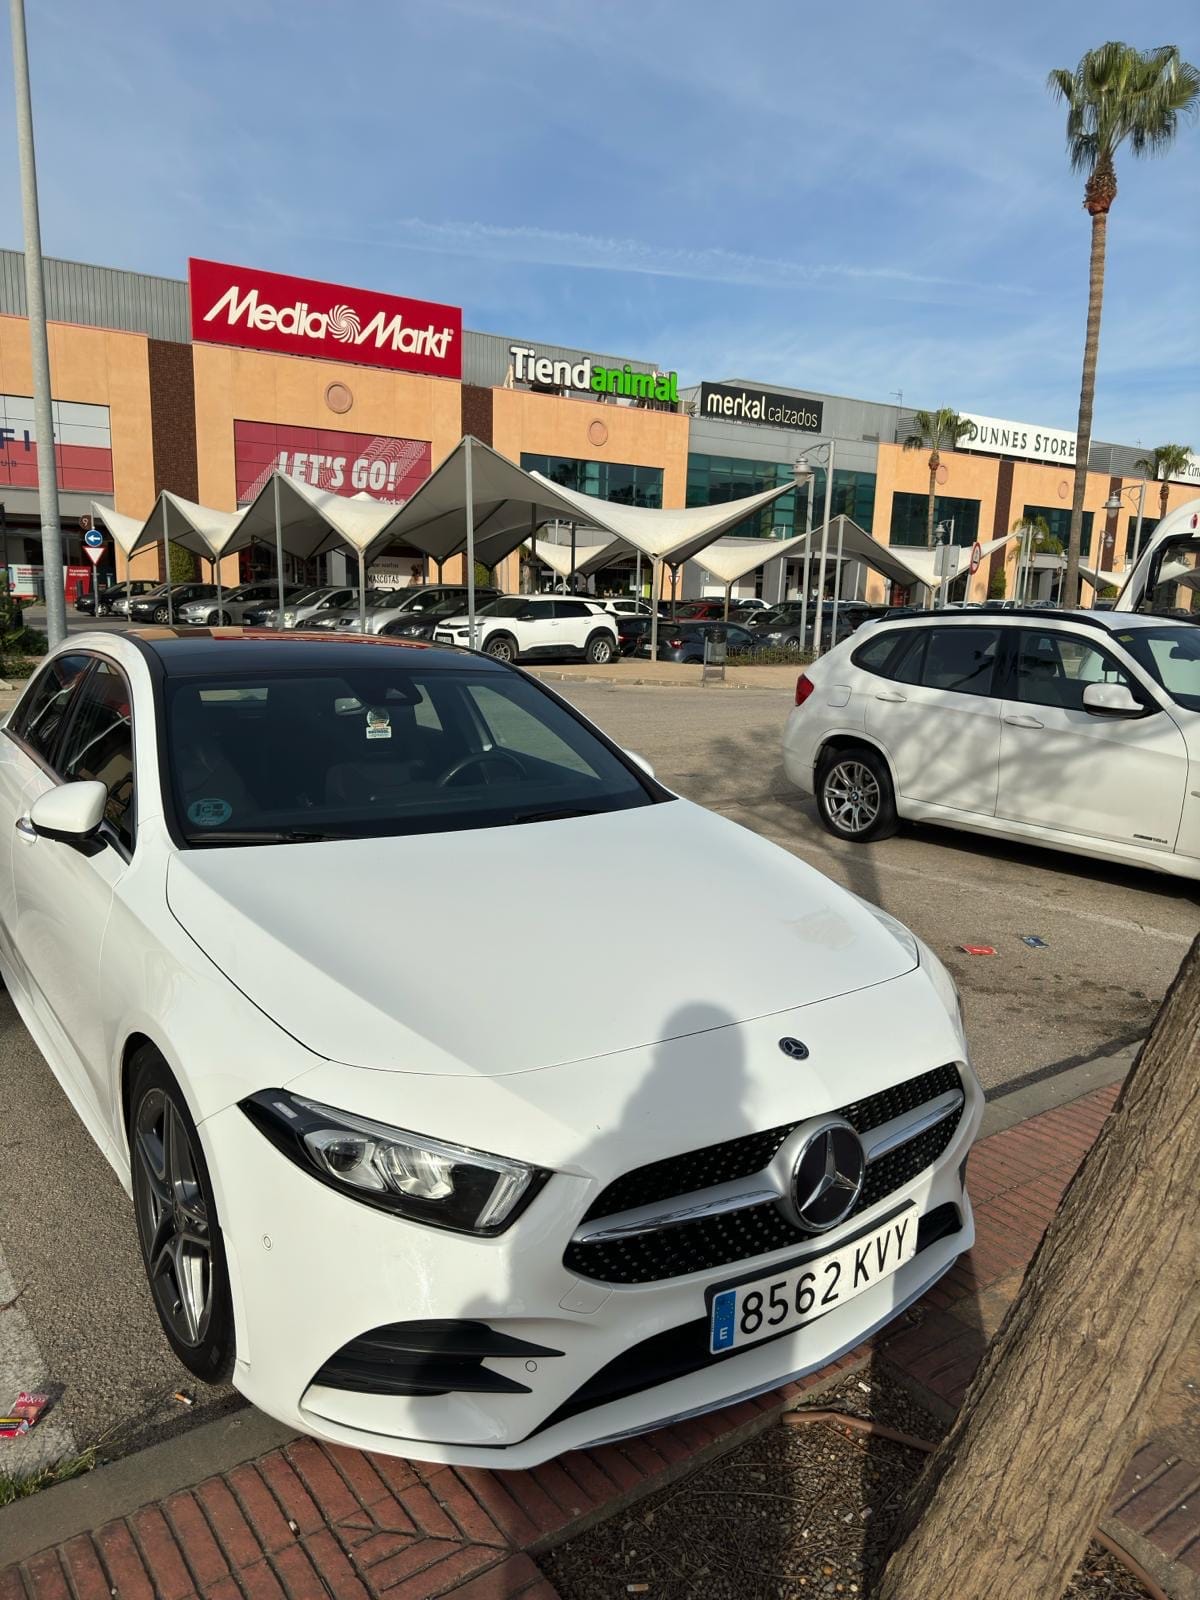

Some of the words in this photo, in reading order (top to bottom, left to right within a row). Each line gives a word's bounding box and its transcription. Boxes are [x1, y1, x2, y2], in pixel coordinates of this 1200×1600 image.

[203, 285, 328, 339] Media
[354, 311, 452, 359] Markt
[509, 346, 680, 403] Tiendanimal
[707, 391, 766, 421] merkal
[768, 404, 818, 428] calzados
[968, 423, 1028, 450] DUNNES
[278, 451, 346, 488] LET'S
[351, 458, 398, 492] GO!
[740, 1261, 842, 1334] 8562
[853, 1218, 909, 1288] KVY
[719, 1326, 729, 1340] E
